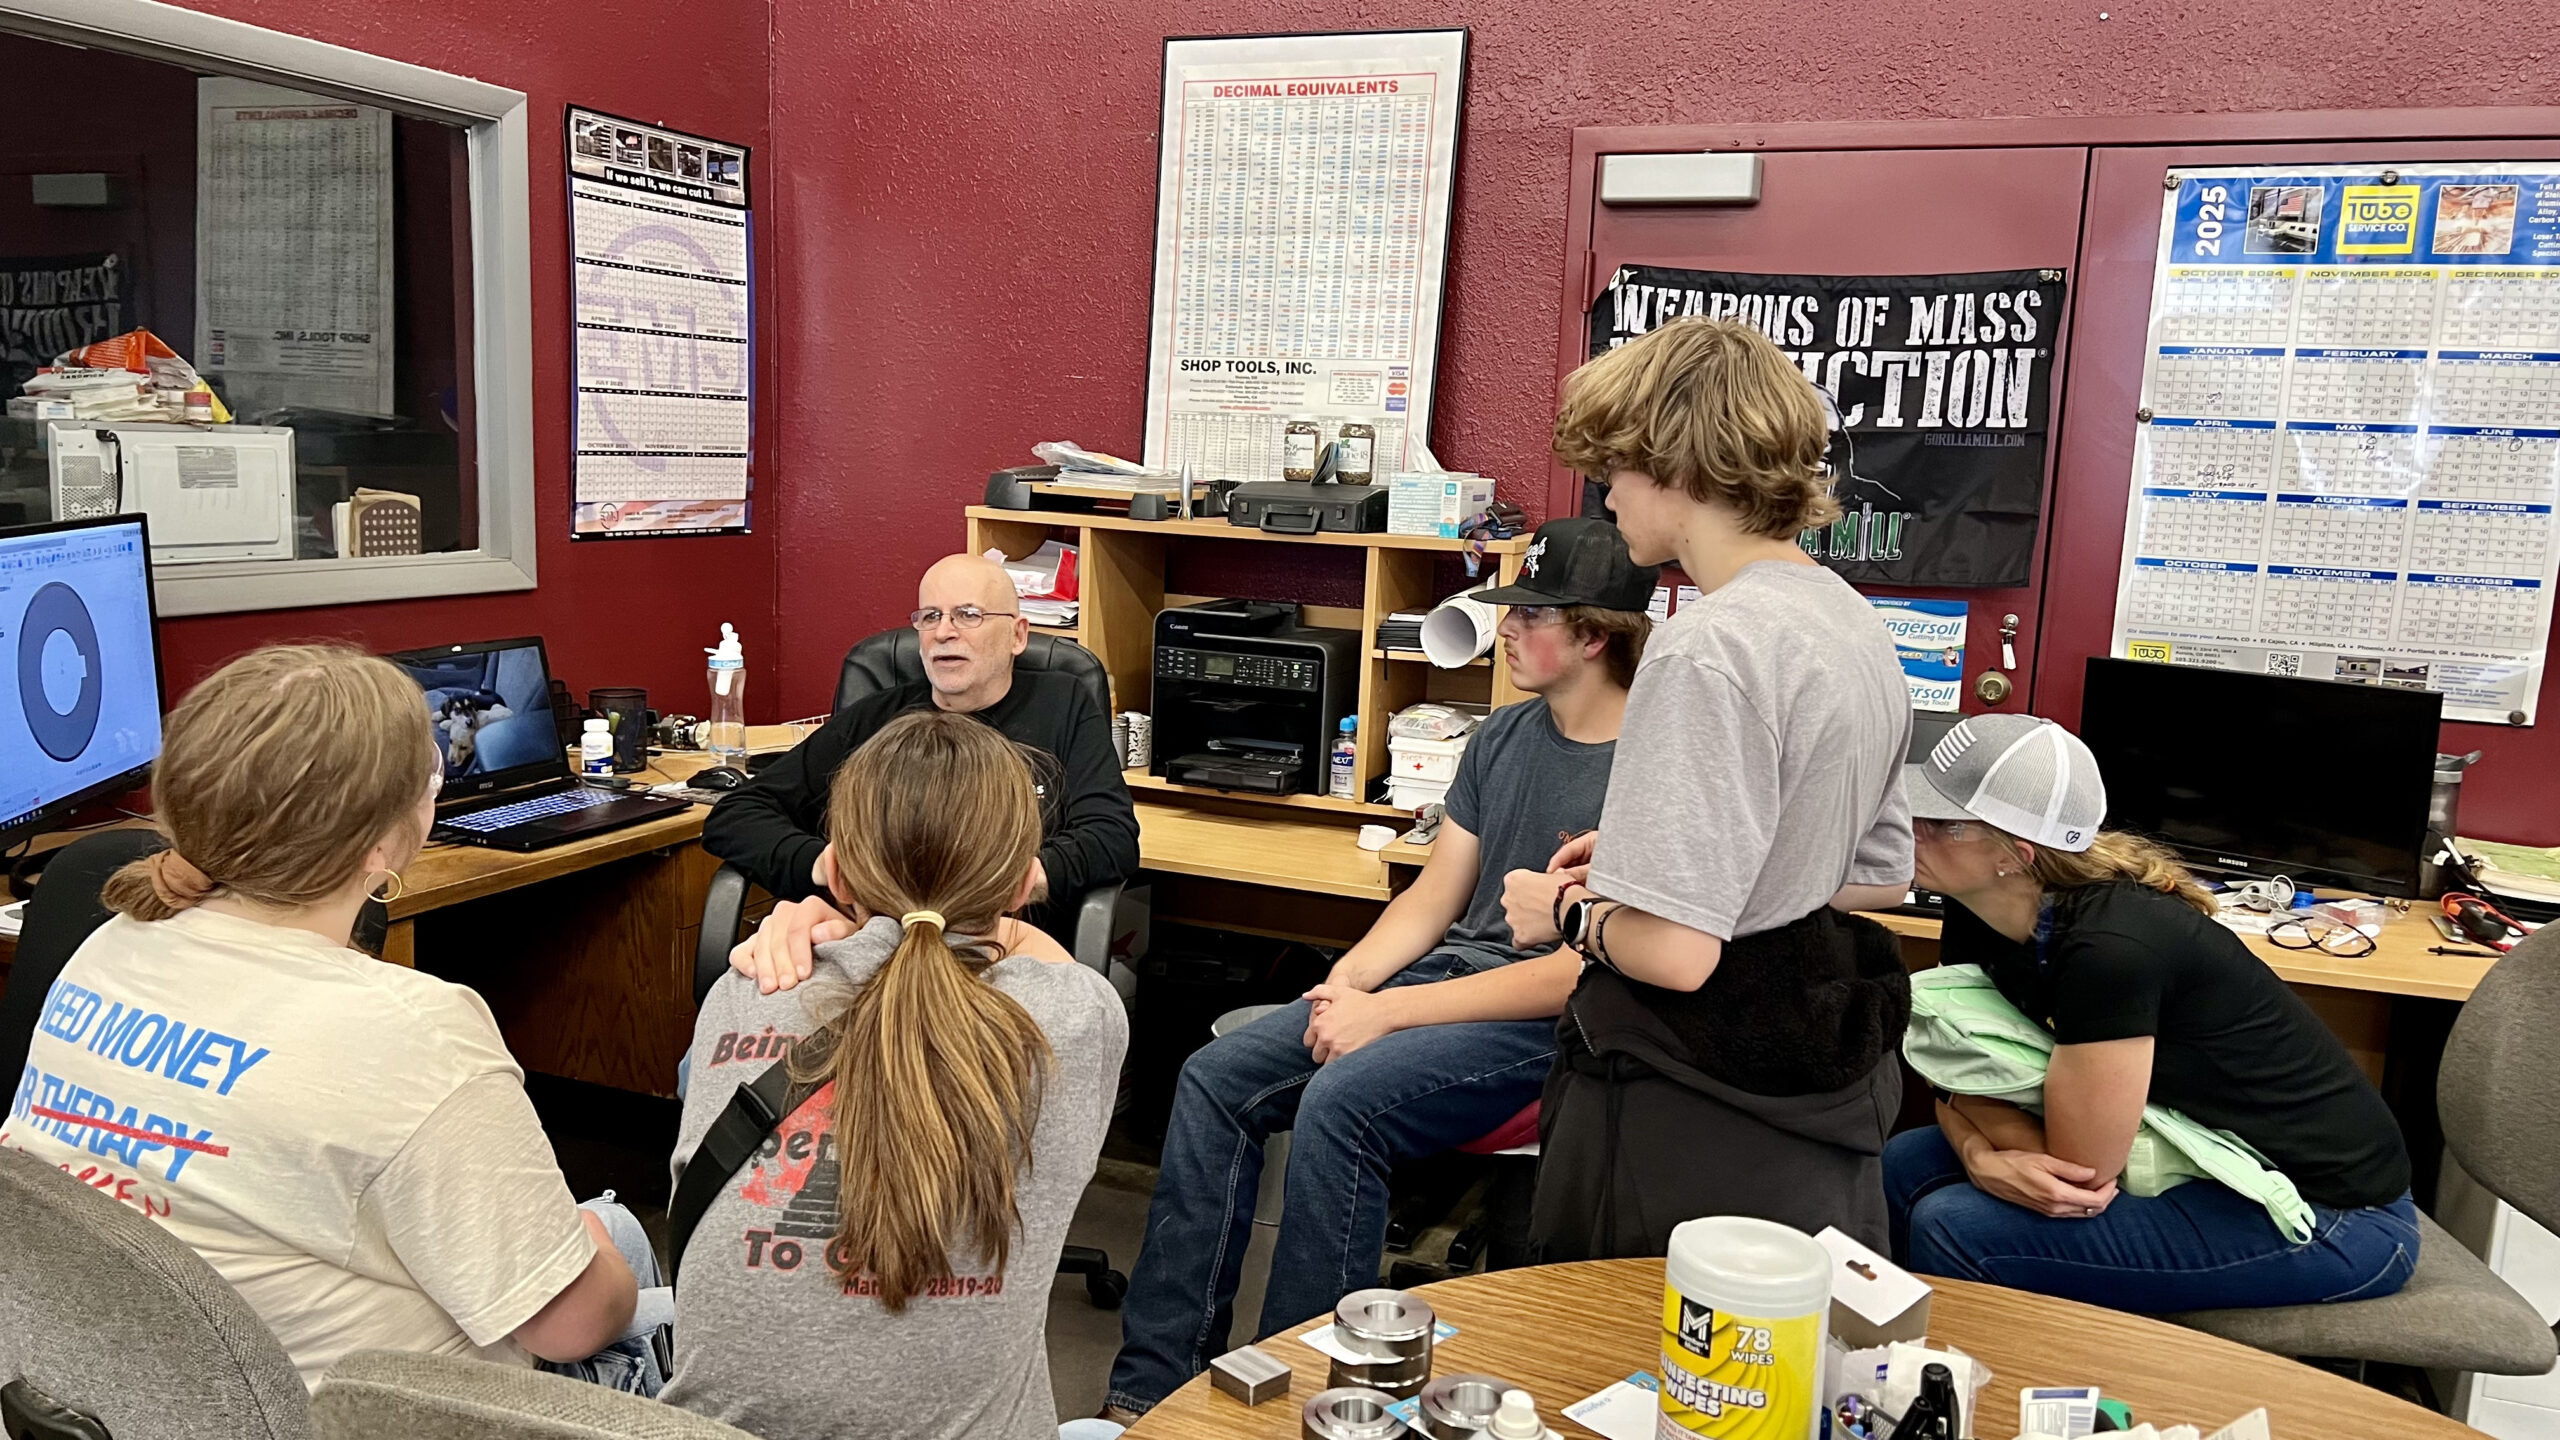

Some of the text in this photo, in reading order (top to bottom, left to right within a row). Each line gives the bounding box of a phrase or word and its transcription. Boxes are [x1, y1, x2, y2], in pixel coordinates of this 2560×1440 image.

[1214, 80, 1399, 98] DECIMAL EQUIVALENTS
[606, 169, 712, 200] If we sell it, we can cut it.
[2195, 185, 2227, 256] 2025
[2348, 223, 2406, 232] SERVICE CO.
[1613, 284, 2042, 348] WEAPONS OF MASS
[2323, 350, 2398, 358] FEBRUARY
[1180, 360, 1317, 375] SHOP TOOLS, INC.
[1925, 433, 2025, 447] GORILLAMILL.COM
[2313, 496, 2371, 504] AUGUST
[2441, 503, 2527, 511] SEPTEMBER
[2164, 561, 2227, 569] OCTOBER
[2292, 567, 2371, 578] NOVEMBER
[2435, 576, 2513, 586] DECEMBER
[1884, 619, 1961, 636] ngersoll
[1909, 634, 1935, 642] Cutting
[1910, 687, 1955, 700] ersoll
[88, 1002, 271, 1096] MONEY
[709, 1025, 798, 1068] Bein
[31, 1073, 213, 1183] THERAPY
[744, 1228, 803, 1270] To
[926, 1276, 1003, 1297] 28:19-20
[1736, 1326, 1772, 1352] 78
[1730, 1351, 1774, 1365] WIPES
[1665, 1377, 1722, 1418] WIPES
